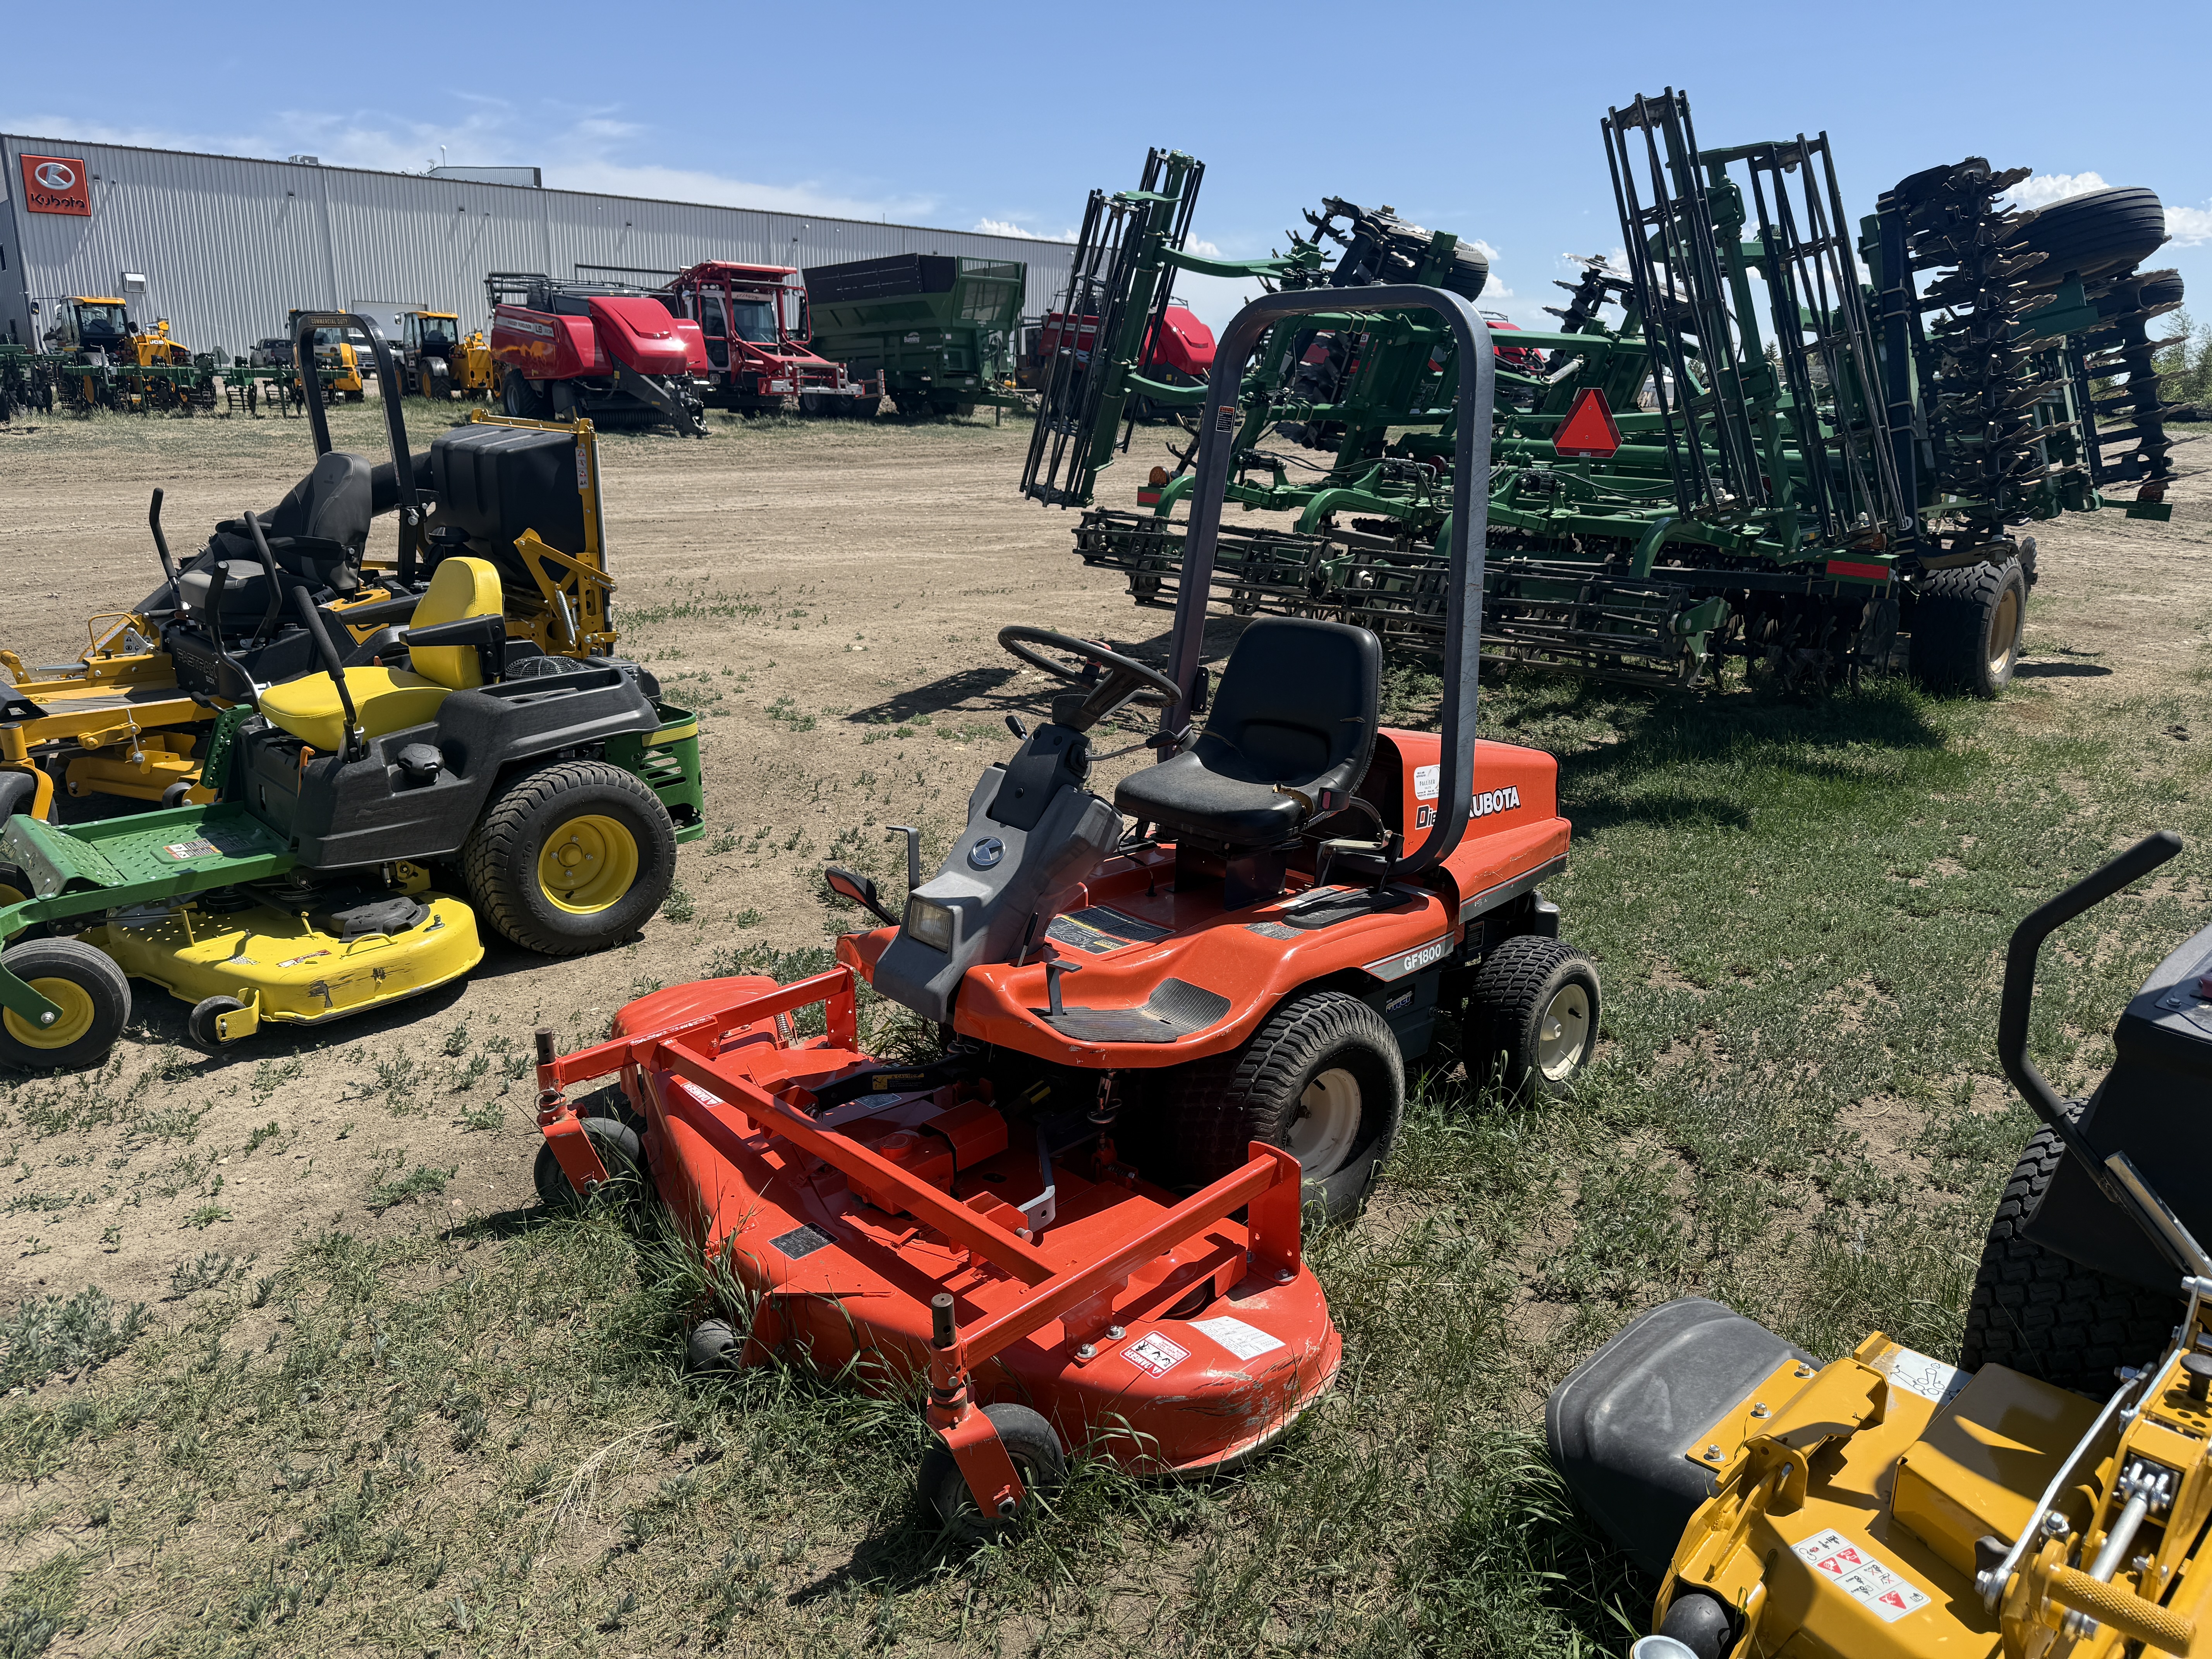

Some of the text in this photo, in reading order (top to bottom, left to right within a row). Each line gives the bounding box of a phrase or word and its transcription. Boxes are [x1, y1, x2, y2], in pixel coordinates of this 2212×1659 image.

[31, 193, 85, 208] Kubota
[177, 648, 218, 678] FASTRAK
[1404, 944, 1441, 971] GF1800
[683, 1083, 712, 1102] DANGER
[1124, 1349, 1154, 1369] DANGER
